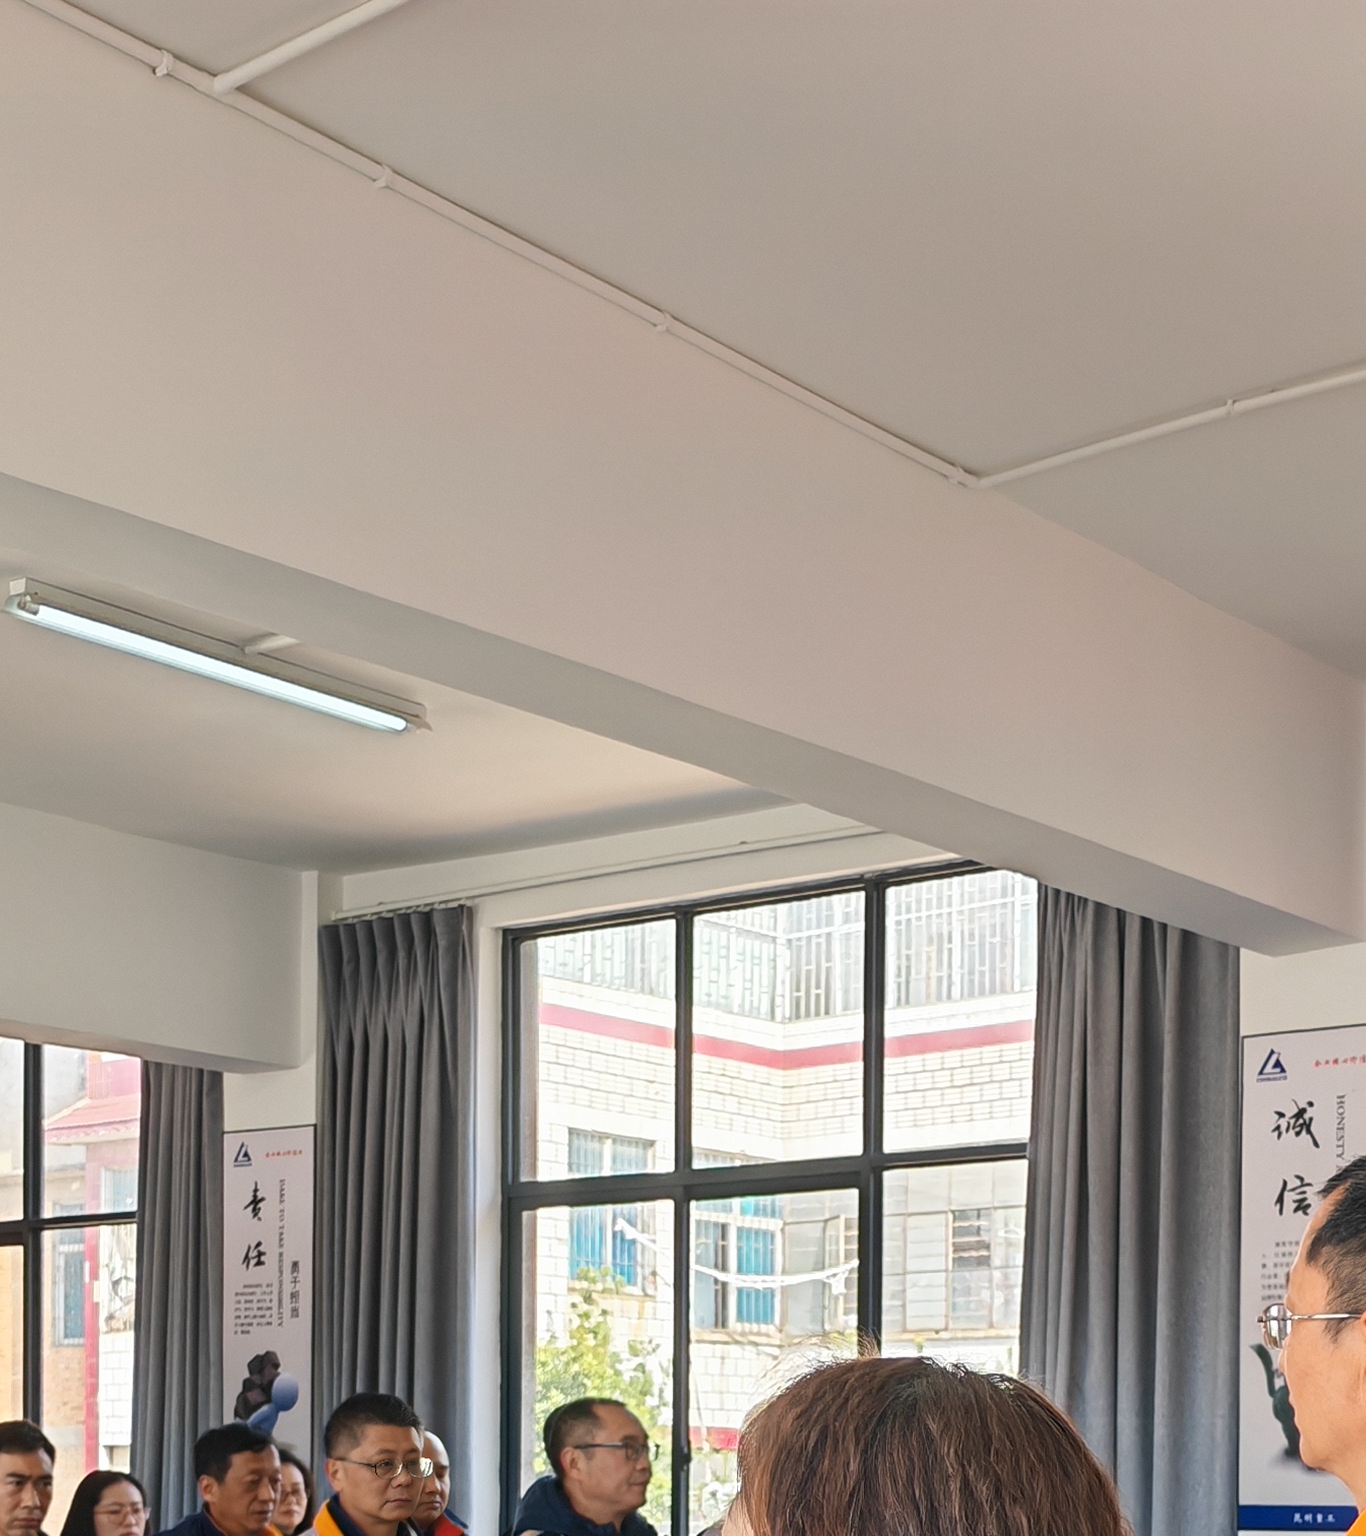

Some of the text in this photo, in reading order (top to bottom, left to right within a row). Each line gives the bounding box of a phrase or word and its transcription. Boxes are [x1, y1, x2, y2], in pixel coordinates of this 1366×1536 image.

[1271, 1098, 1320, 1217] 诚信
[1336, 1094, 1346, 1160] HONESTY
[242, 1180, 267, 1271] 责任
